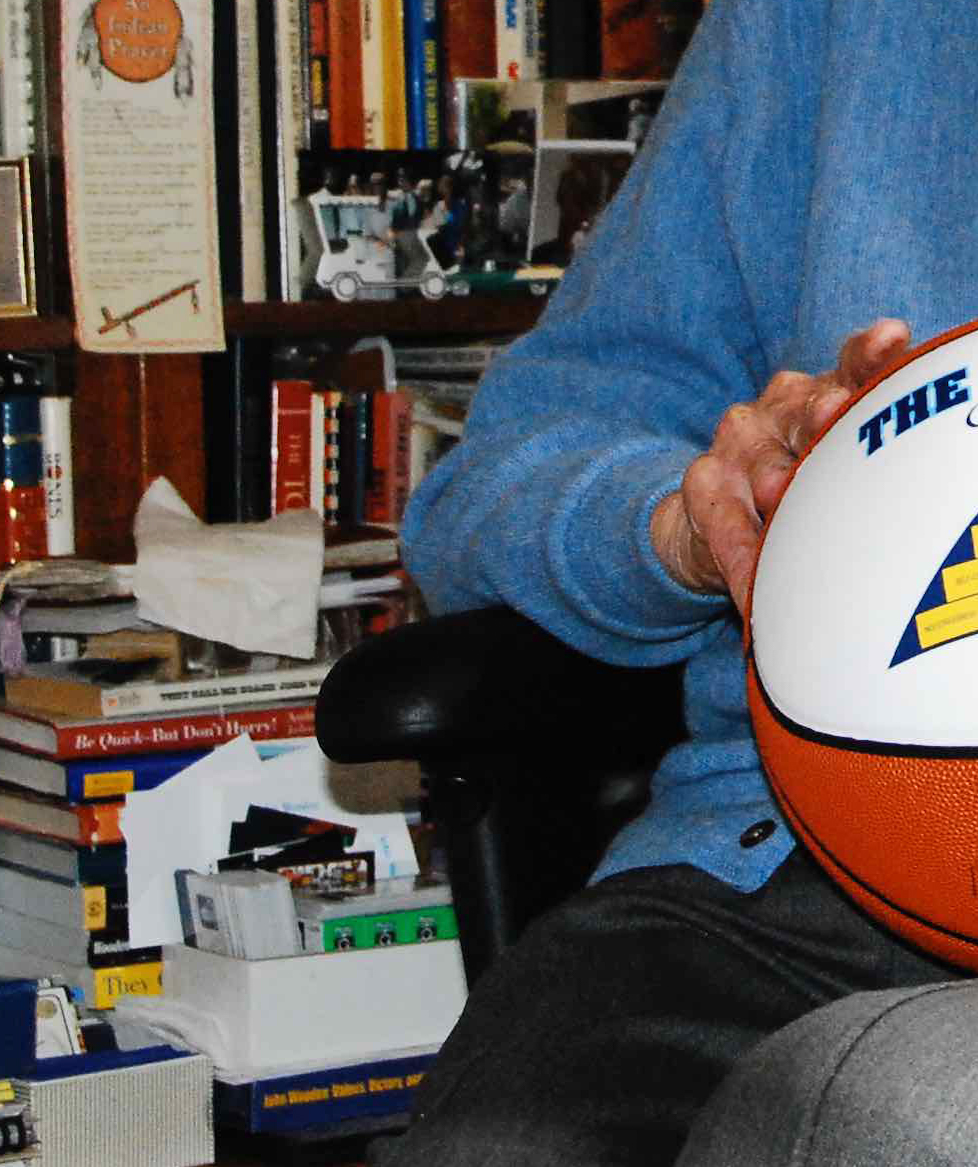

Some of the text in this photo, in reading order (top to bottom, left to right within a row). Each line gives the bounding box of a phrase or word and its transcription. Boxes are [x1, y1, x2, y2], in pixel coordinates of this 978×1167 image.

[858, 367, 970, 457] THE
[74, 734, 95, 751] Be
[183, 722, 224, 740] Don't
[226, 717, 278, 736] Hurry!
[102, 976, 148, 996] They
